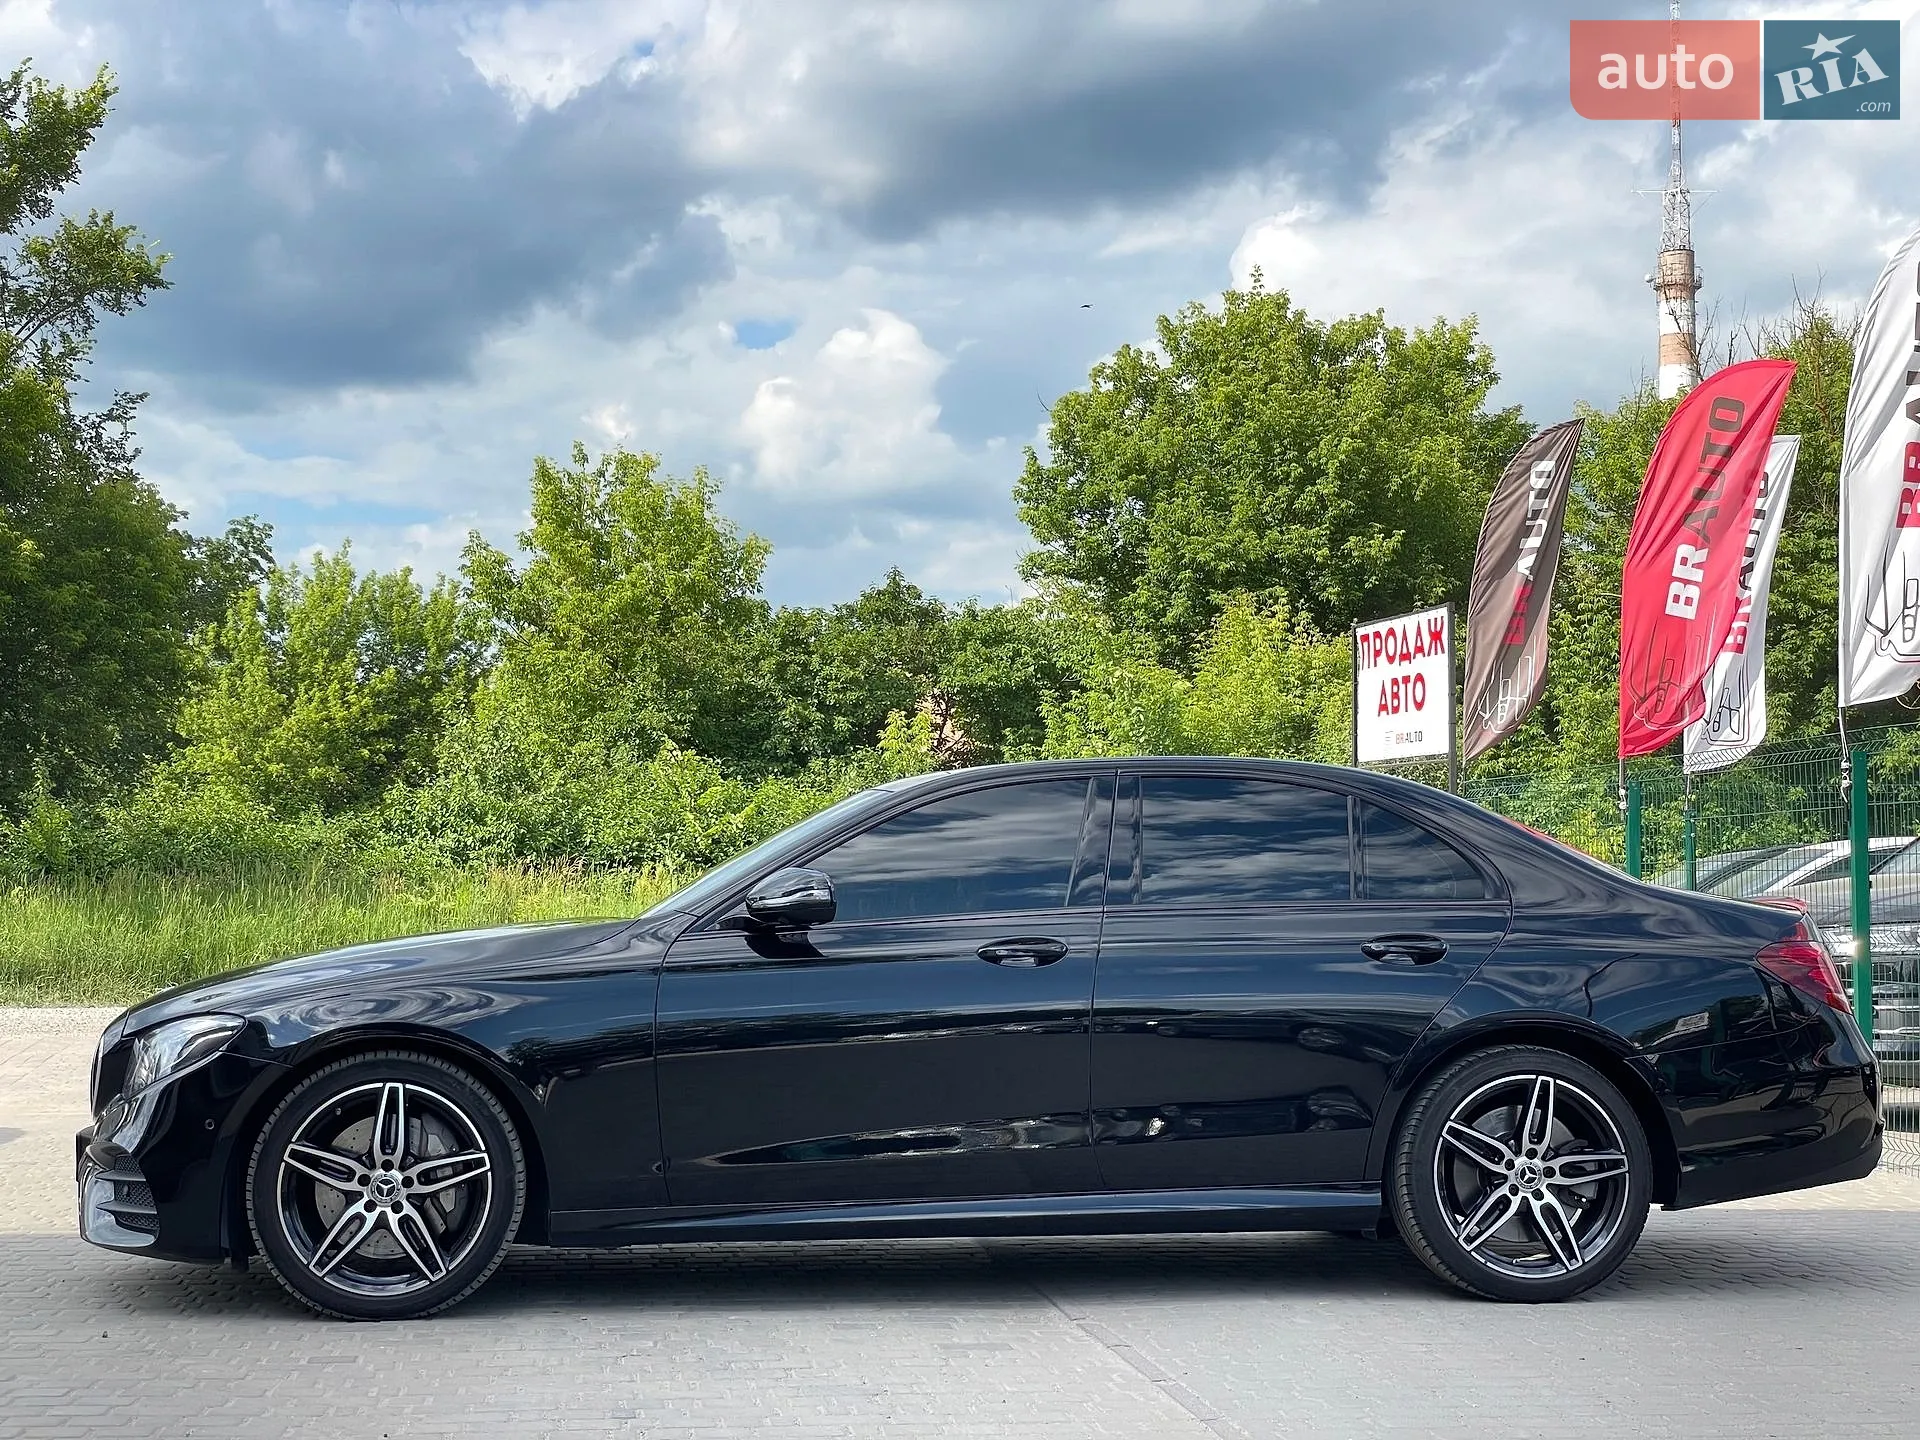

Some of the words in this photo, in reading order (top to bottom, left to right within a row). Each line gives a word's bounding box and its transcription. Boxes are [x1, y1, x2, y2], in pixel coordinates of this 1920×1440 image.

[1664, 396, 1747, 621] BRAUTO
[1359, 615, 1446, 671] ПРОДАЖ
[1377, 672, 1427, 717] АВТО
